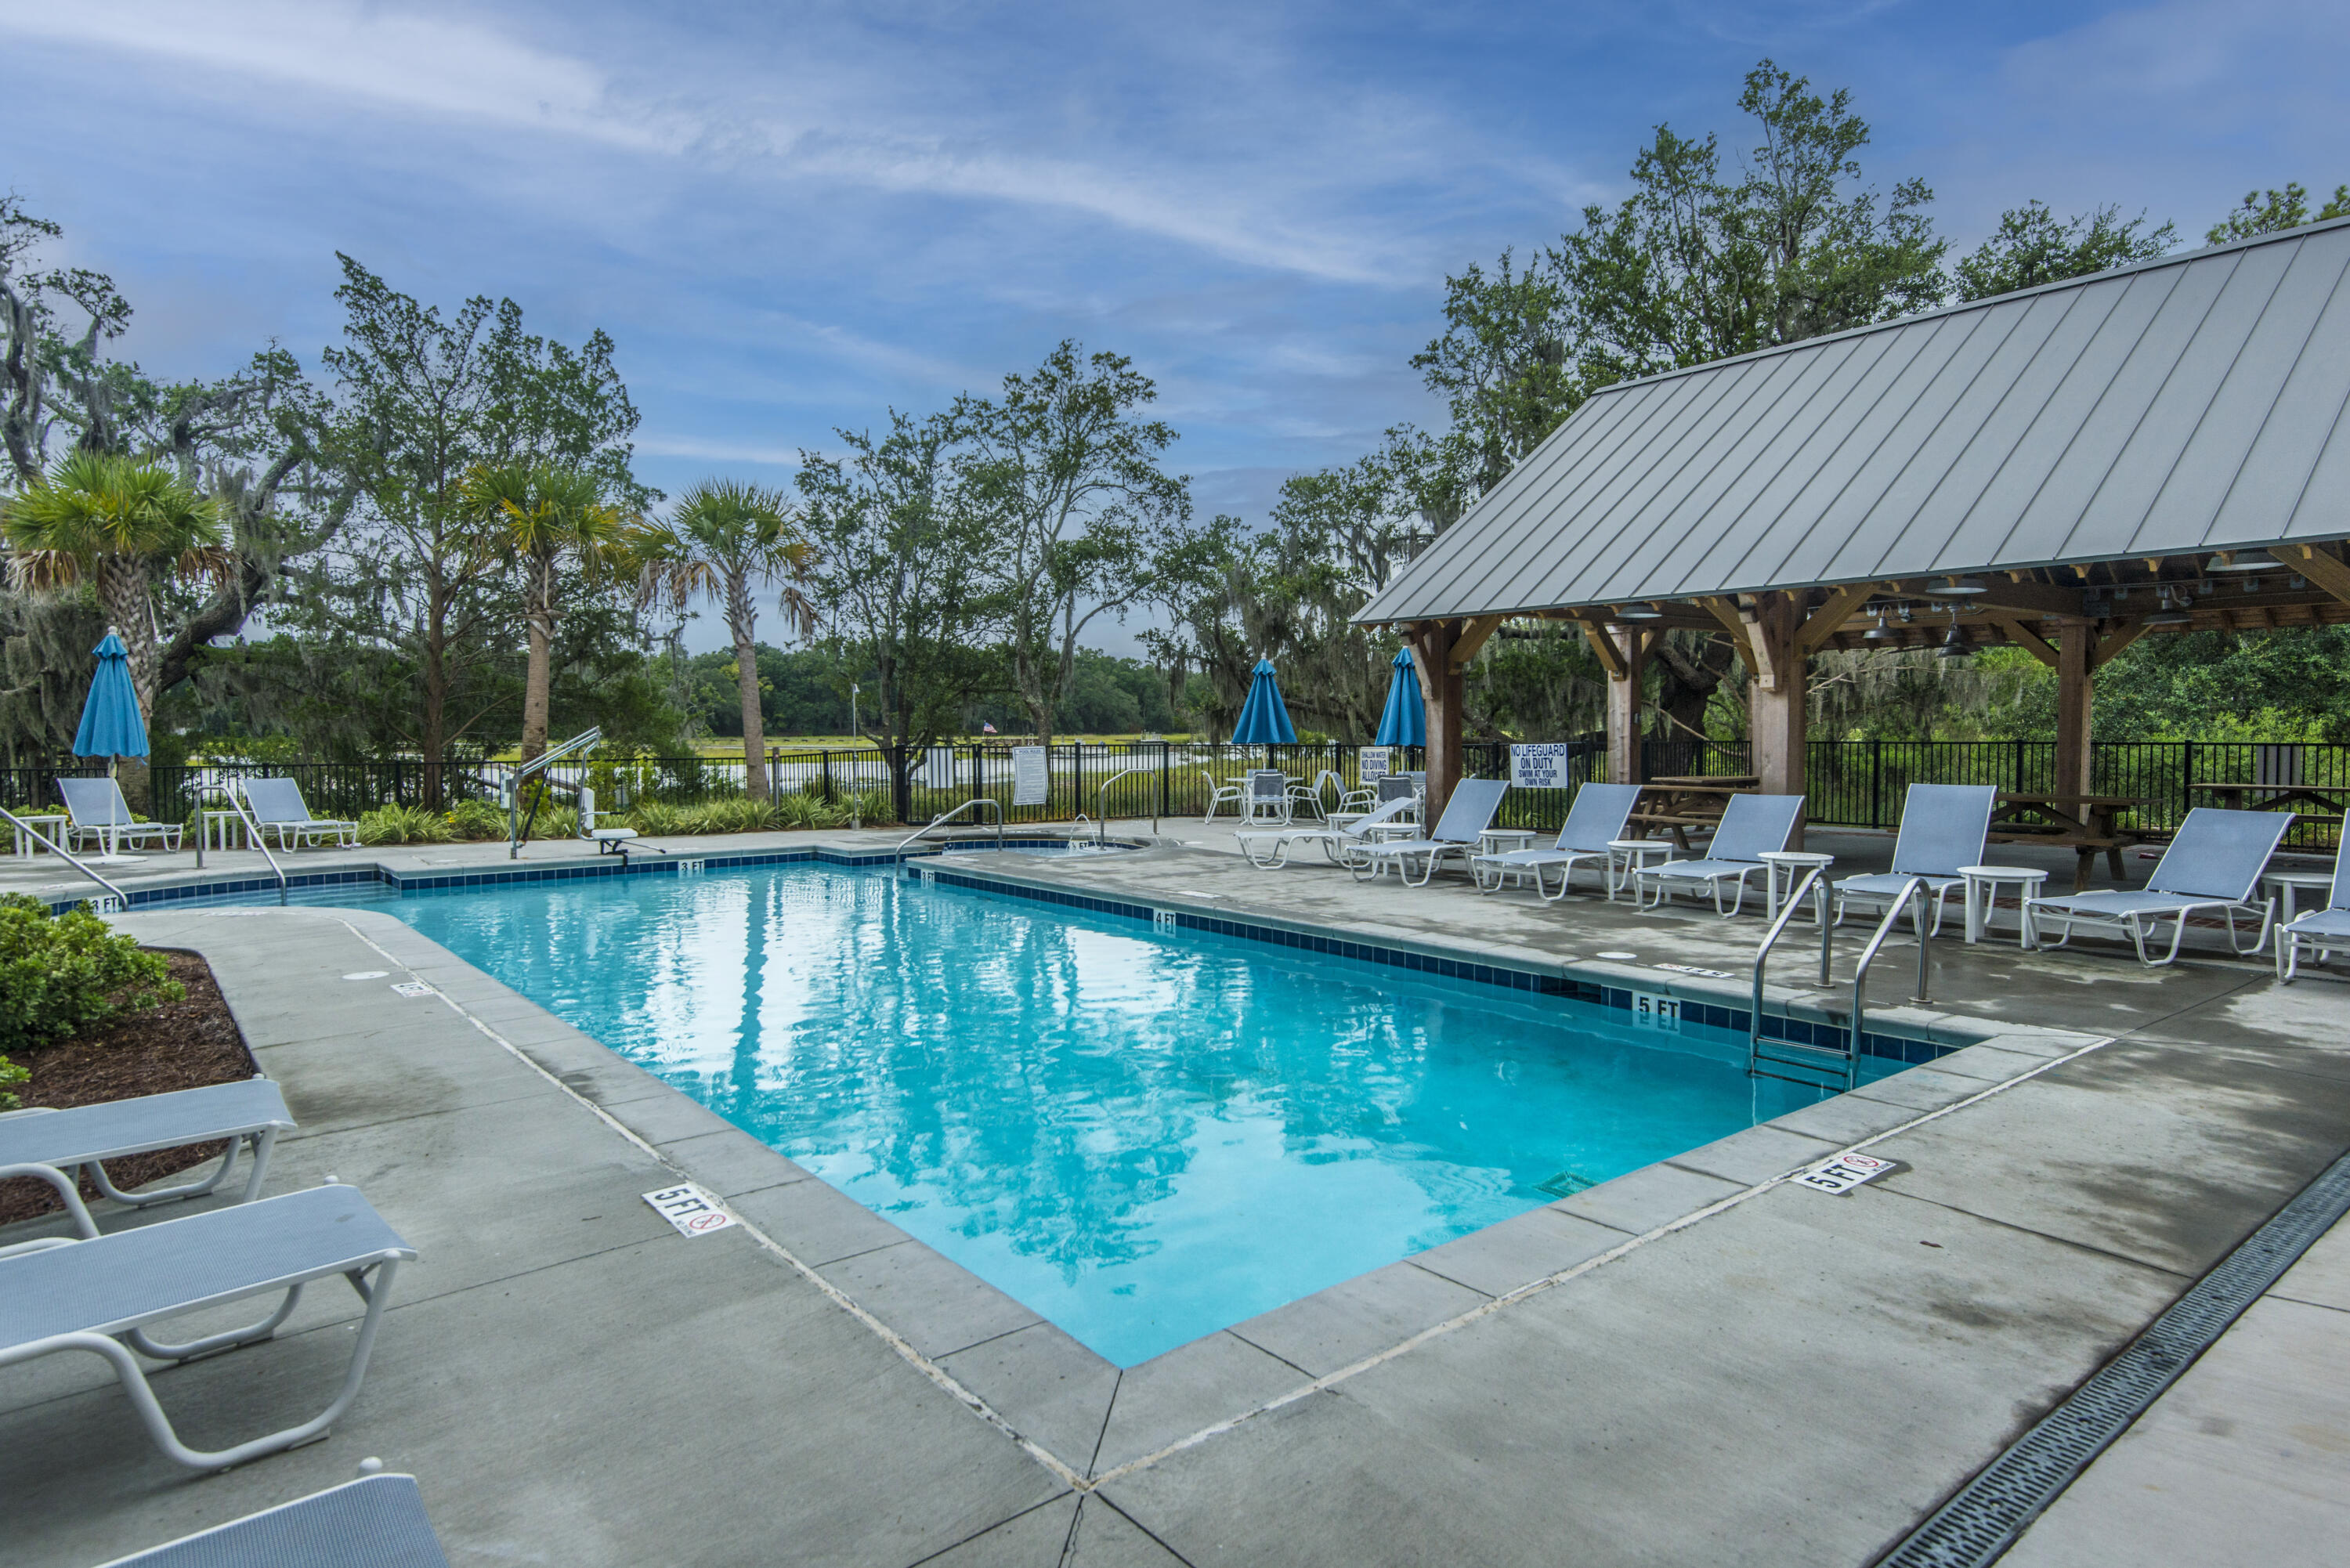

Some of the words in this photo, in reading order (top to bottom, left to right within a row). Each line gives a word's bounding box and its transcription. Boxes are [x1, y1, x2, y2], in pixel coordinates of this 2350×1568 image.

[1510, 745, 1520, 757] NO
[1521, 744, 1565, 757] LIFEGUARD
[1361, 759, 1368, 770] NO
[1369, 759, 1386, 770] DIVING
[1520, 757, 1531, 769] ON
[1533, 757, 1553, 769] DUTY
[1518, 769, 1533, 778] SWIM
[1534, 769, 1541, 778] AT
[1542, 769, 1557, 778] YOUR
[1524, 778, 1538, 786] OWN
[682, 862, 688, 871] 3
[692, 861, 703, 872] FT
[927, 872, 935, 880] FT
[103, 897, 117, 909] FT
[1156, 912, 1162, 923] 4
[1165, 912, 1175, 924] FT
[1639, 995, 1650, 1013] 5
[1658, 999, 1679, 1018] FT
[1820, 1163, 1867, 1181] FT
[1804, 1175, 1842, 1188] 5
[654, 1187, 691, 1201] 5
[663, 1197, 710, 1216] FT
